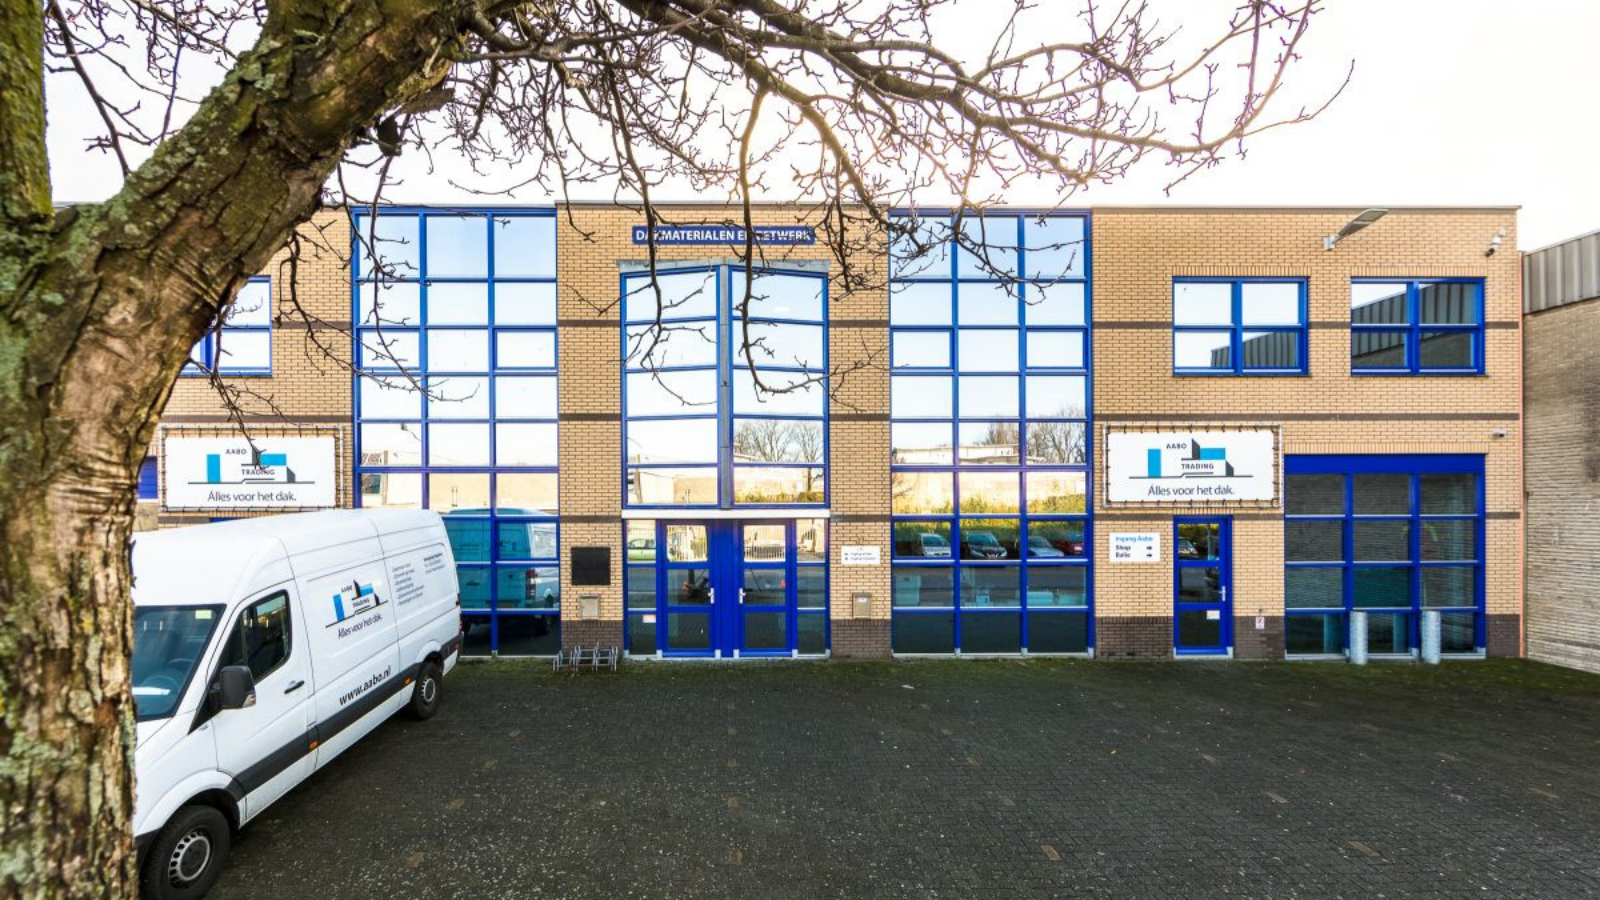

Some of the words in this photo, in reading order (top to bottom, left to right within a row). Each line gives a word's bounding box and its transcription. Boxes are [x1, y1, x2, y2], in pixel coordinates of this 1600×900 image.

[207, 490, 231, 502] Alles
[232, 493, 255, 502] voor
[256, 490, 274, 502] het
[275, 490, 297, 502] dak.
[1148, 485, 1171, 496] Alles
[1172, 487, 1195, 496] voor
[1196, 484, 1212, 496] het
[339, 664, 391, 706] www.aabo.nl
